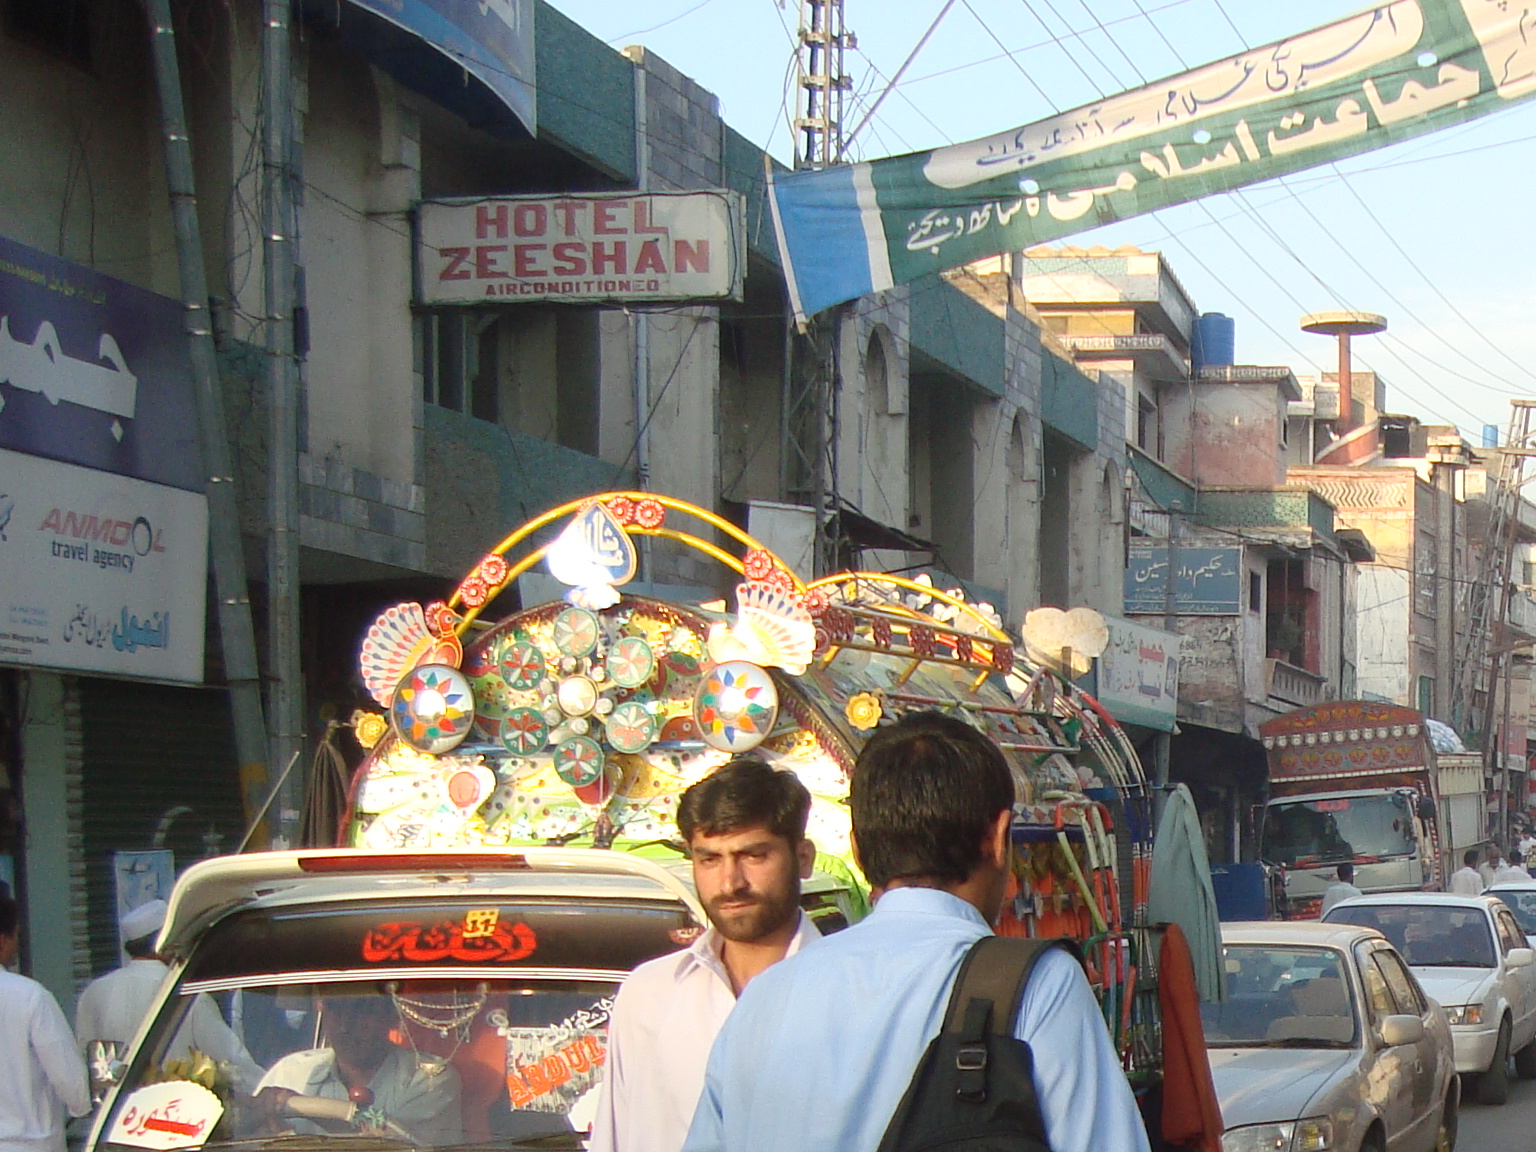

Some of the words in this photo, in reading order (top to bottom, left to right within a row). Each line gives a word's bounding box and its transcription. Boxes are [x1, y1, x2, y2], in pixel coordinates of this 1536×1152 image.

[1266, 61, 1481, 157] جماعت
[1046, 119, 1261, 222] اسلامی
[475, 200, 669, 240] HOTEL
[439, 239, 711, 281] ZEESHAN
[485, 279, 660, 297] AIRCONDITIONED
[52, 538, 89, 563] travel
[92, 548, 136, 573] agency
[506, 1034, 607, 1107] ABDUL
